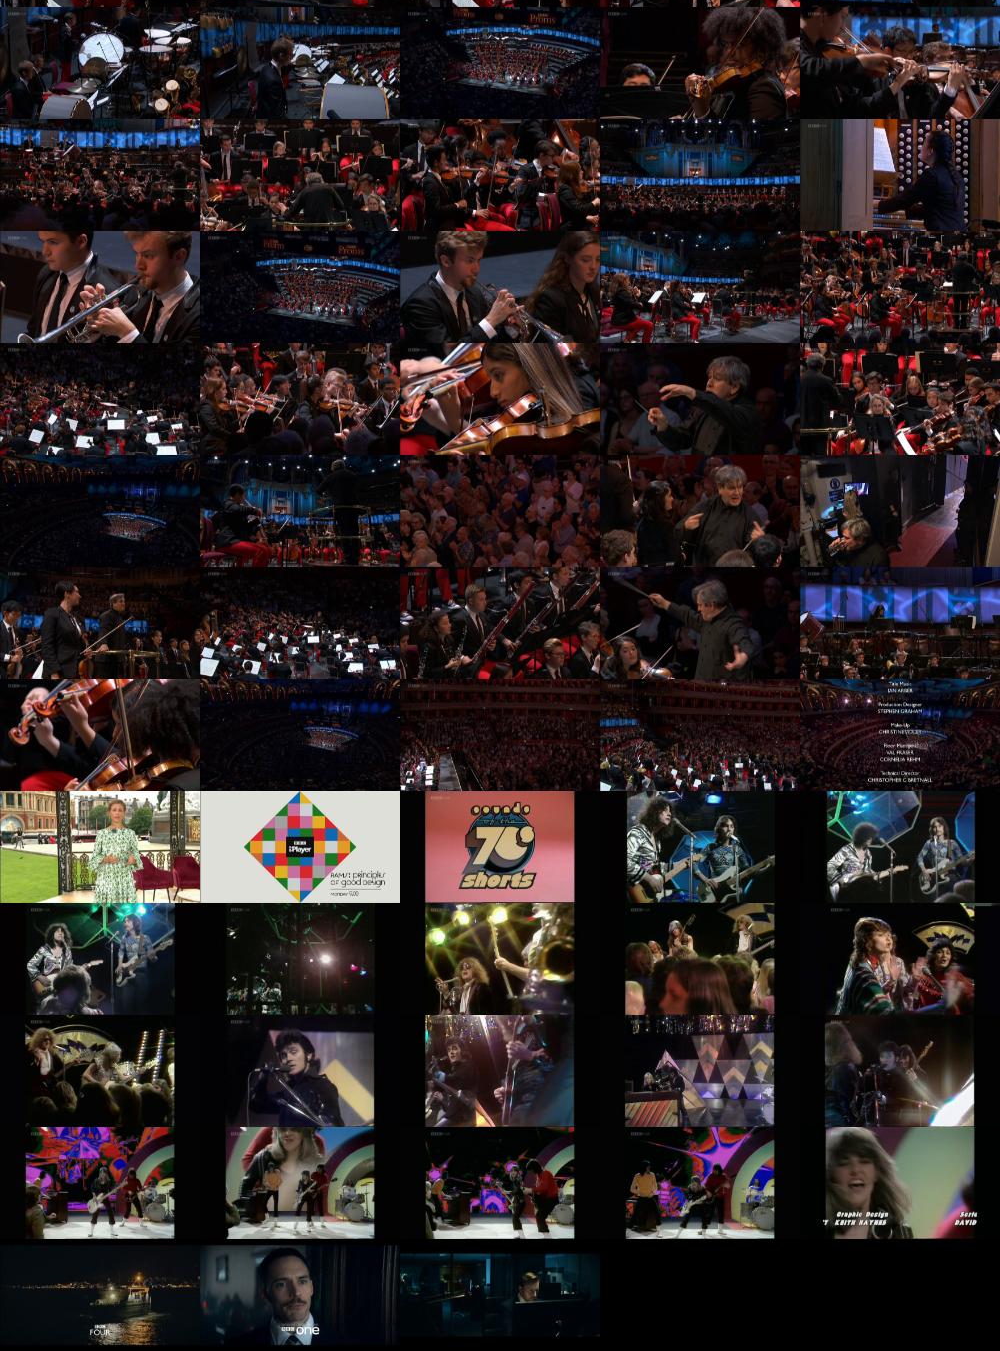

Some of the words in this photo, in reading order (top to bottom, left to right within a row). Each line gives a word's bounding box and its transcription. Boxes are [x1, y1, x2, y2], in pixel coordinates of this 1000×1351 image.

[341, 879, 361, 887] good
[459, 870, 536, 889] shorts
[296, 1326, 320, 1335] one
